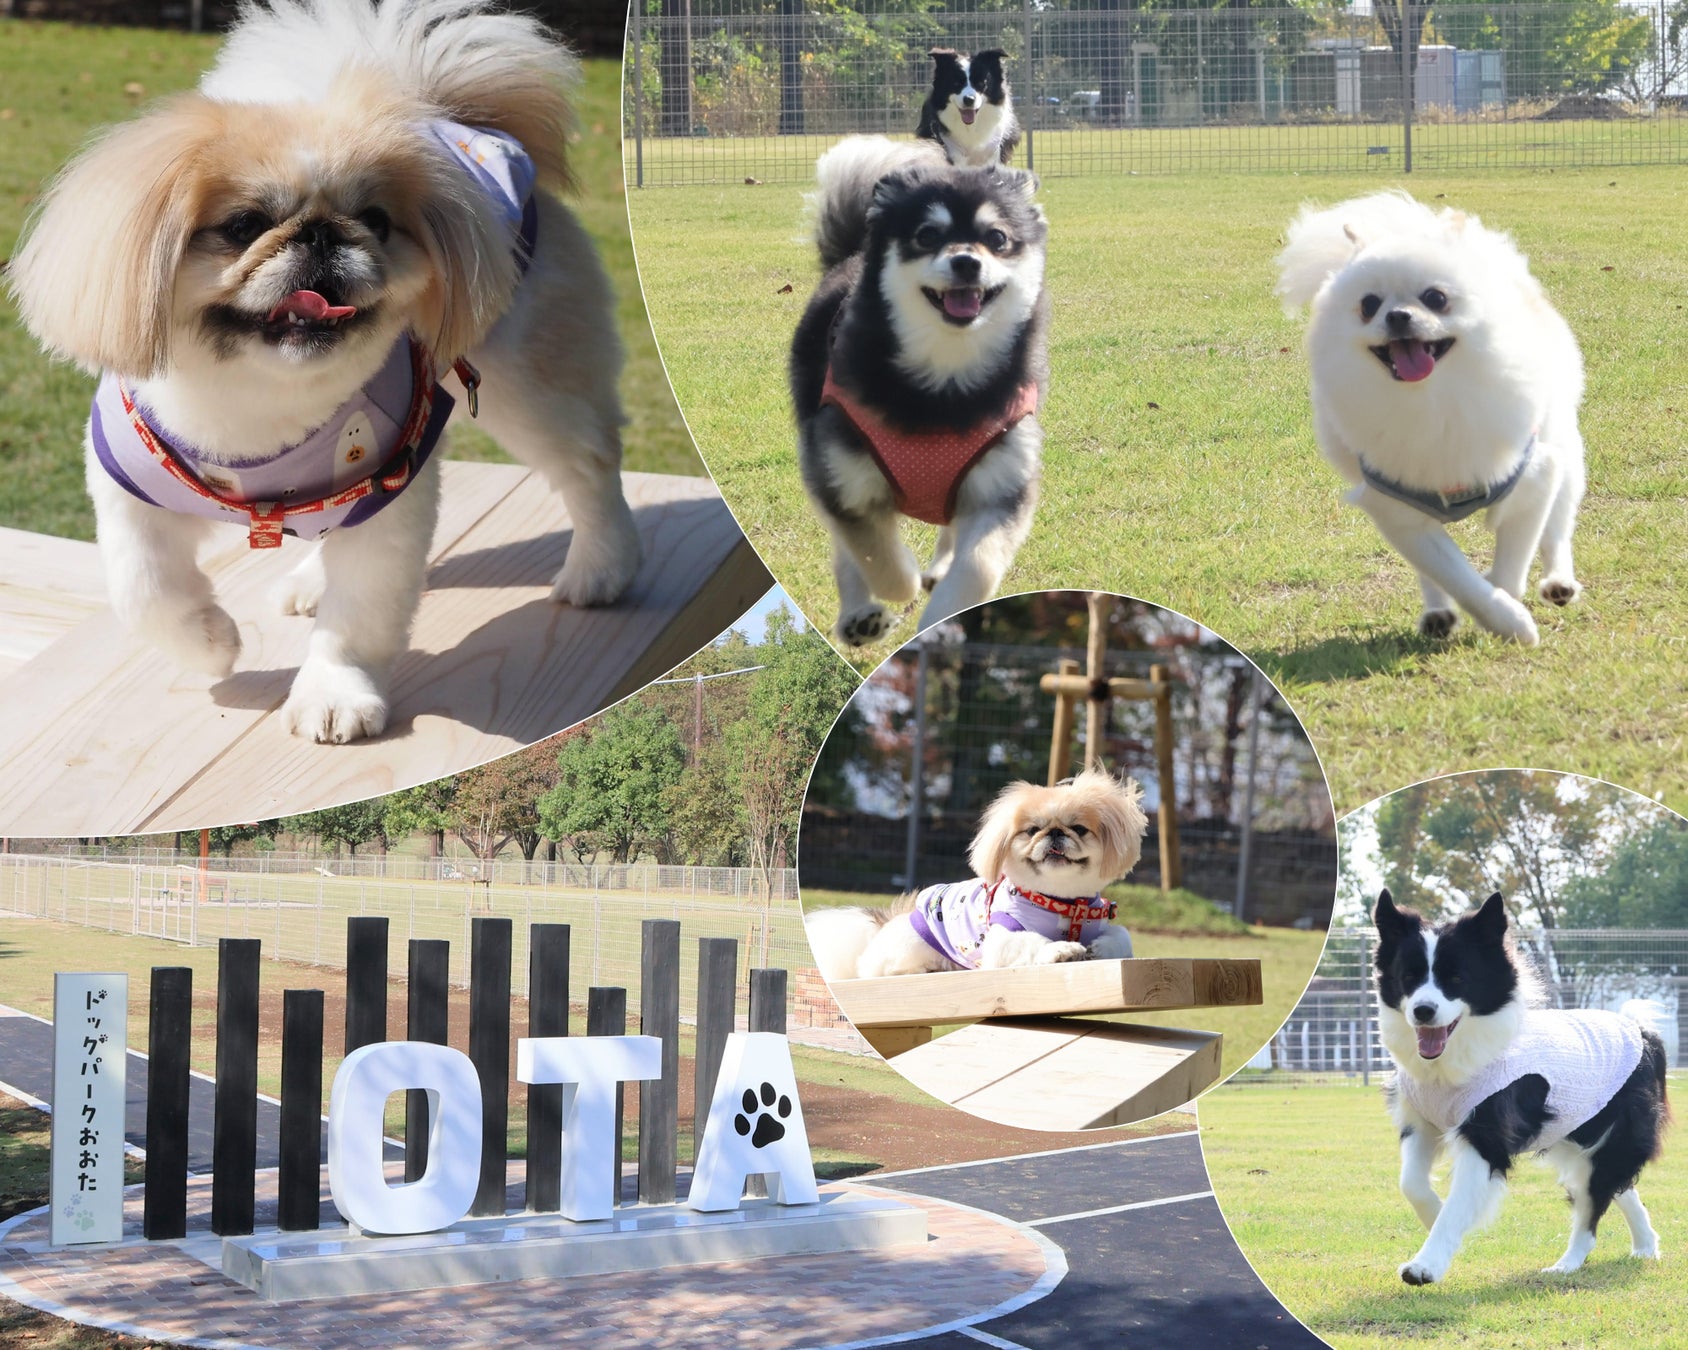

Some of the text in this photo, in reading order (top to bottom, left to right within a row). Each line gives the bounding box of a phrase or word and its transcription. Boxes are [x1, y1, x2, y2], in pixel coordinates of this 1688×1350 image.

[78, 989, 108, 1191] ドッグパークおおた
[328, 1032, 819, 1234] OTA
